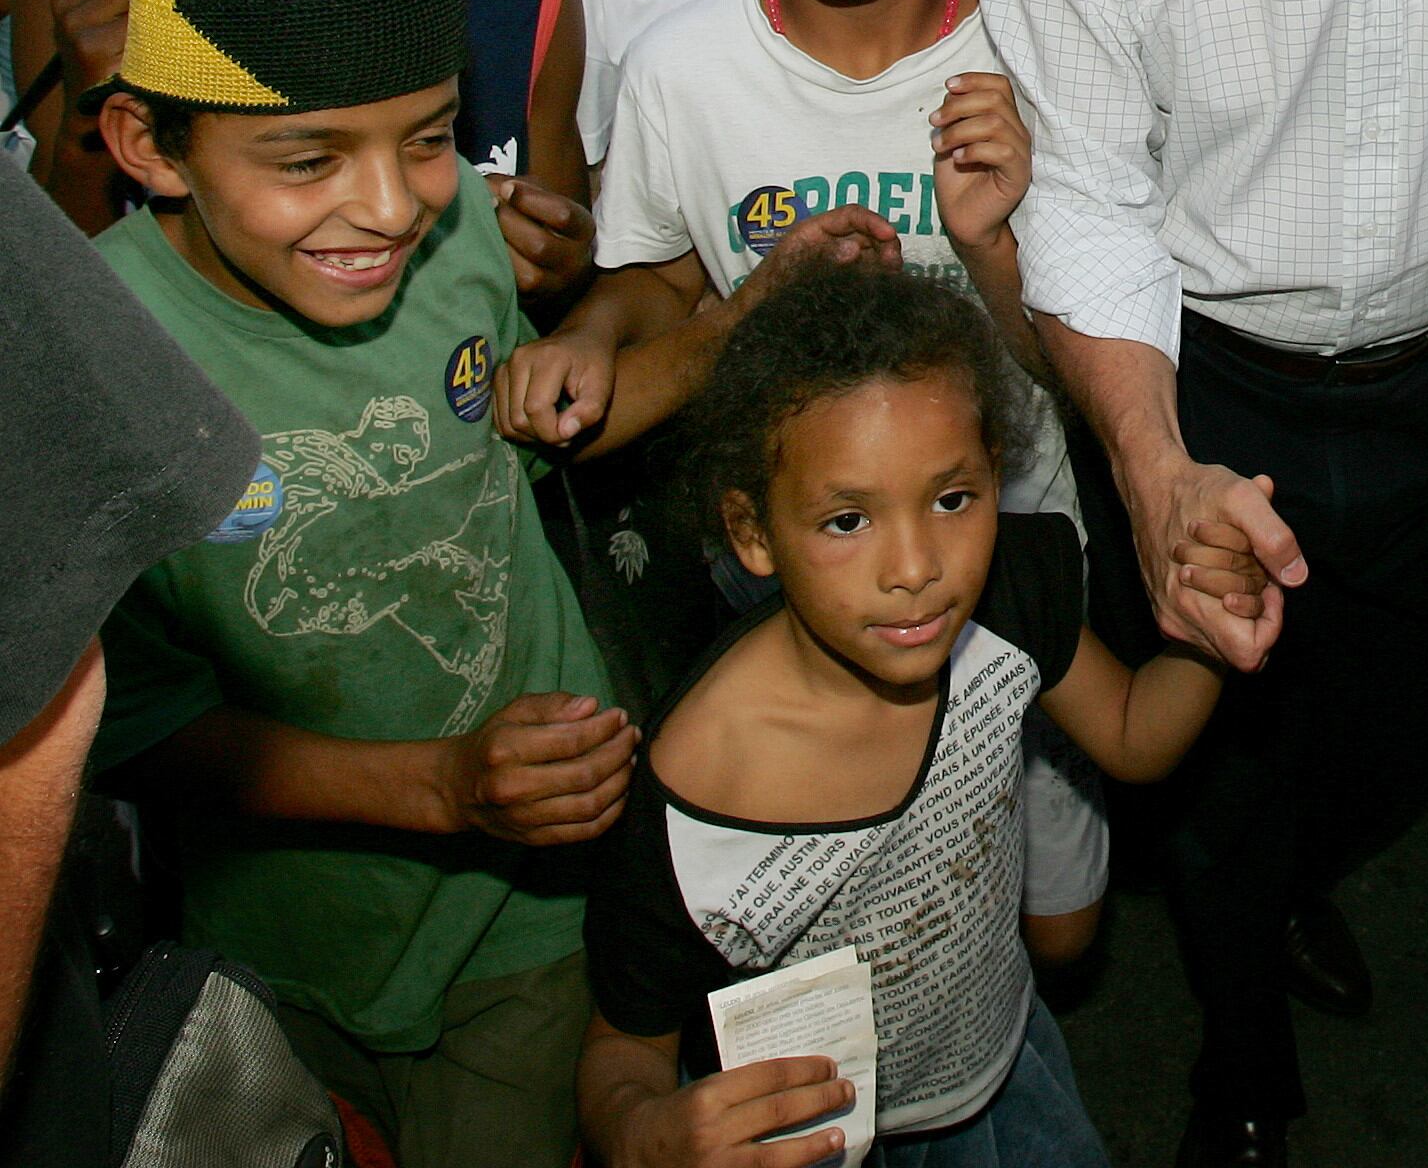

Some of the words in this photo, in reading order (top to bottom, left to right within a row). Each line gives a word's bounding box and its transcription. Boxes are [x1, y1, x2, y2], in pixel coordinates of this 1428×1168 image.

[747, 190, 797, 228] 45
[453, 338, 487, 390] 45
[246, 481, 273, 495] DO
[992, 663, 1026, 696] JAMAIS
[971, 739, 987, 759] UN
[987, 722, 1007, 744] PEU
[1007, 709, 1023, 727] DE
[919, 786, 952, 814] FOND
[955, 763, 985, 790] DANS
[985, 747, 1005, 767] DES
[965, 757, 1010, 802] NOUVEAU
[925, 821, 960, 844] VOUS
[960, 785, 1000, 823] PARLEZ
[946, 827, 971, 849] QUE
[729, 884, 749, 910] J'AI
[746, 834, 796, 884] TERMINO
[783, 876, 810, 902] UNE
[808, 837, 847, 877] TOURS
[863, 870, 932, 910] POUVAIENT
[935, 858, 952, 874] EN
[776, 894, 818, 933] FORCE
[814, 877, 835, 899] DE
[850, 913, 874, 930] EST
[876, 896, 918, 920] TOUTE
[921, 884, 940, 901] MA
[949, 885, 962, 901] JE
[880, 973, 930, 1000] TOUTES
[932, 957, 955, 978] LES
[883, 993, 920, 1014] POUR
[922, 982, 940, 998] EN
[928, 993, 945, 1007] LA
